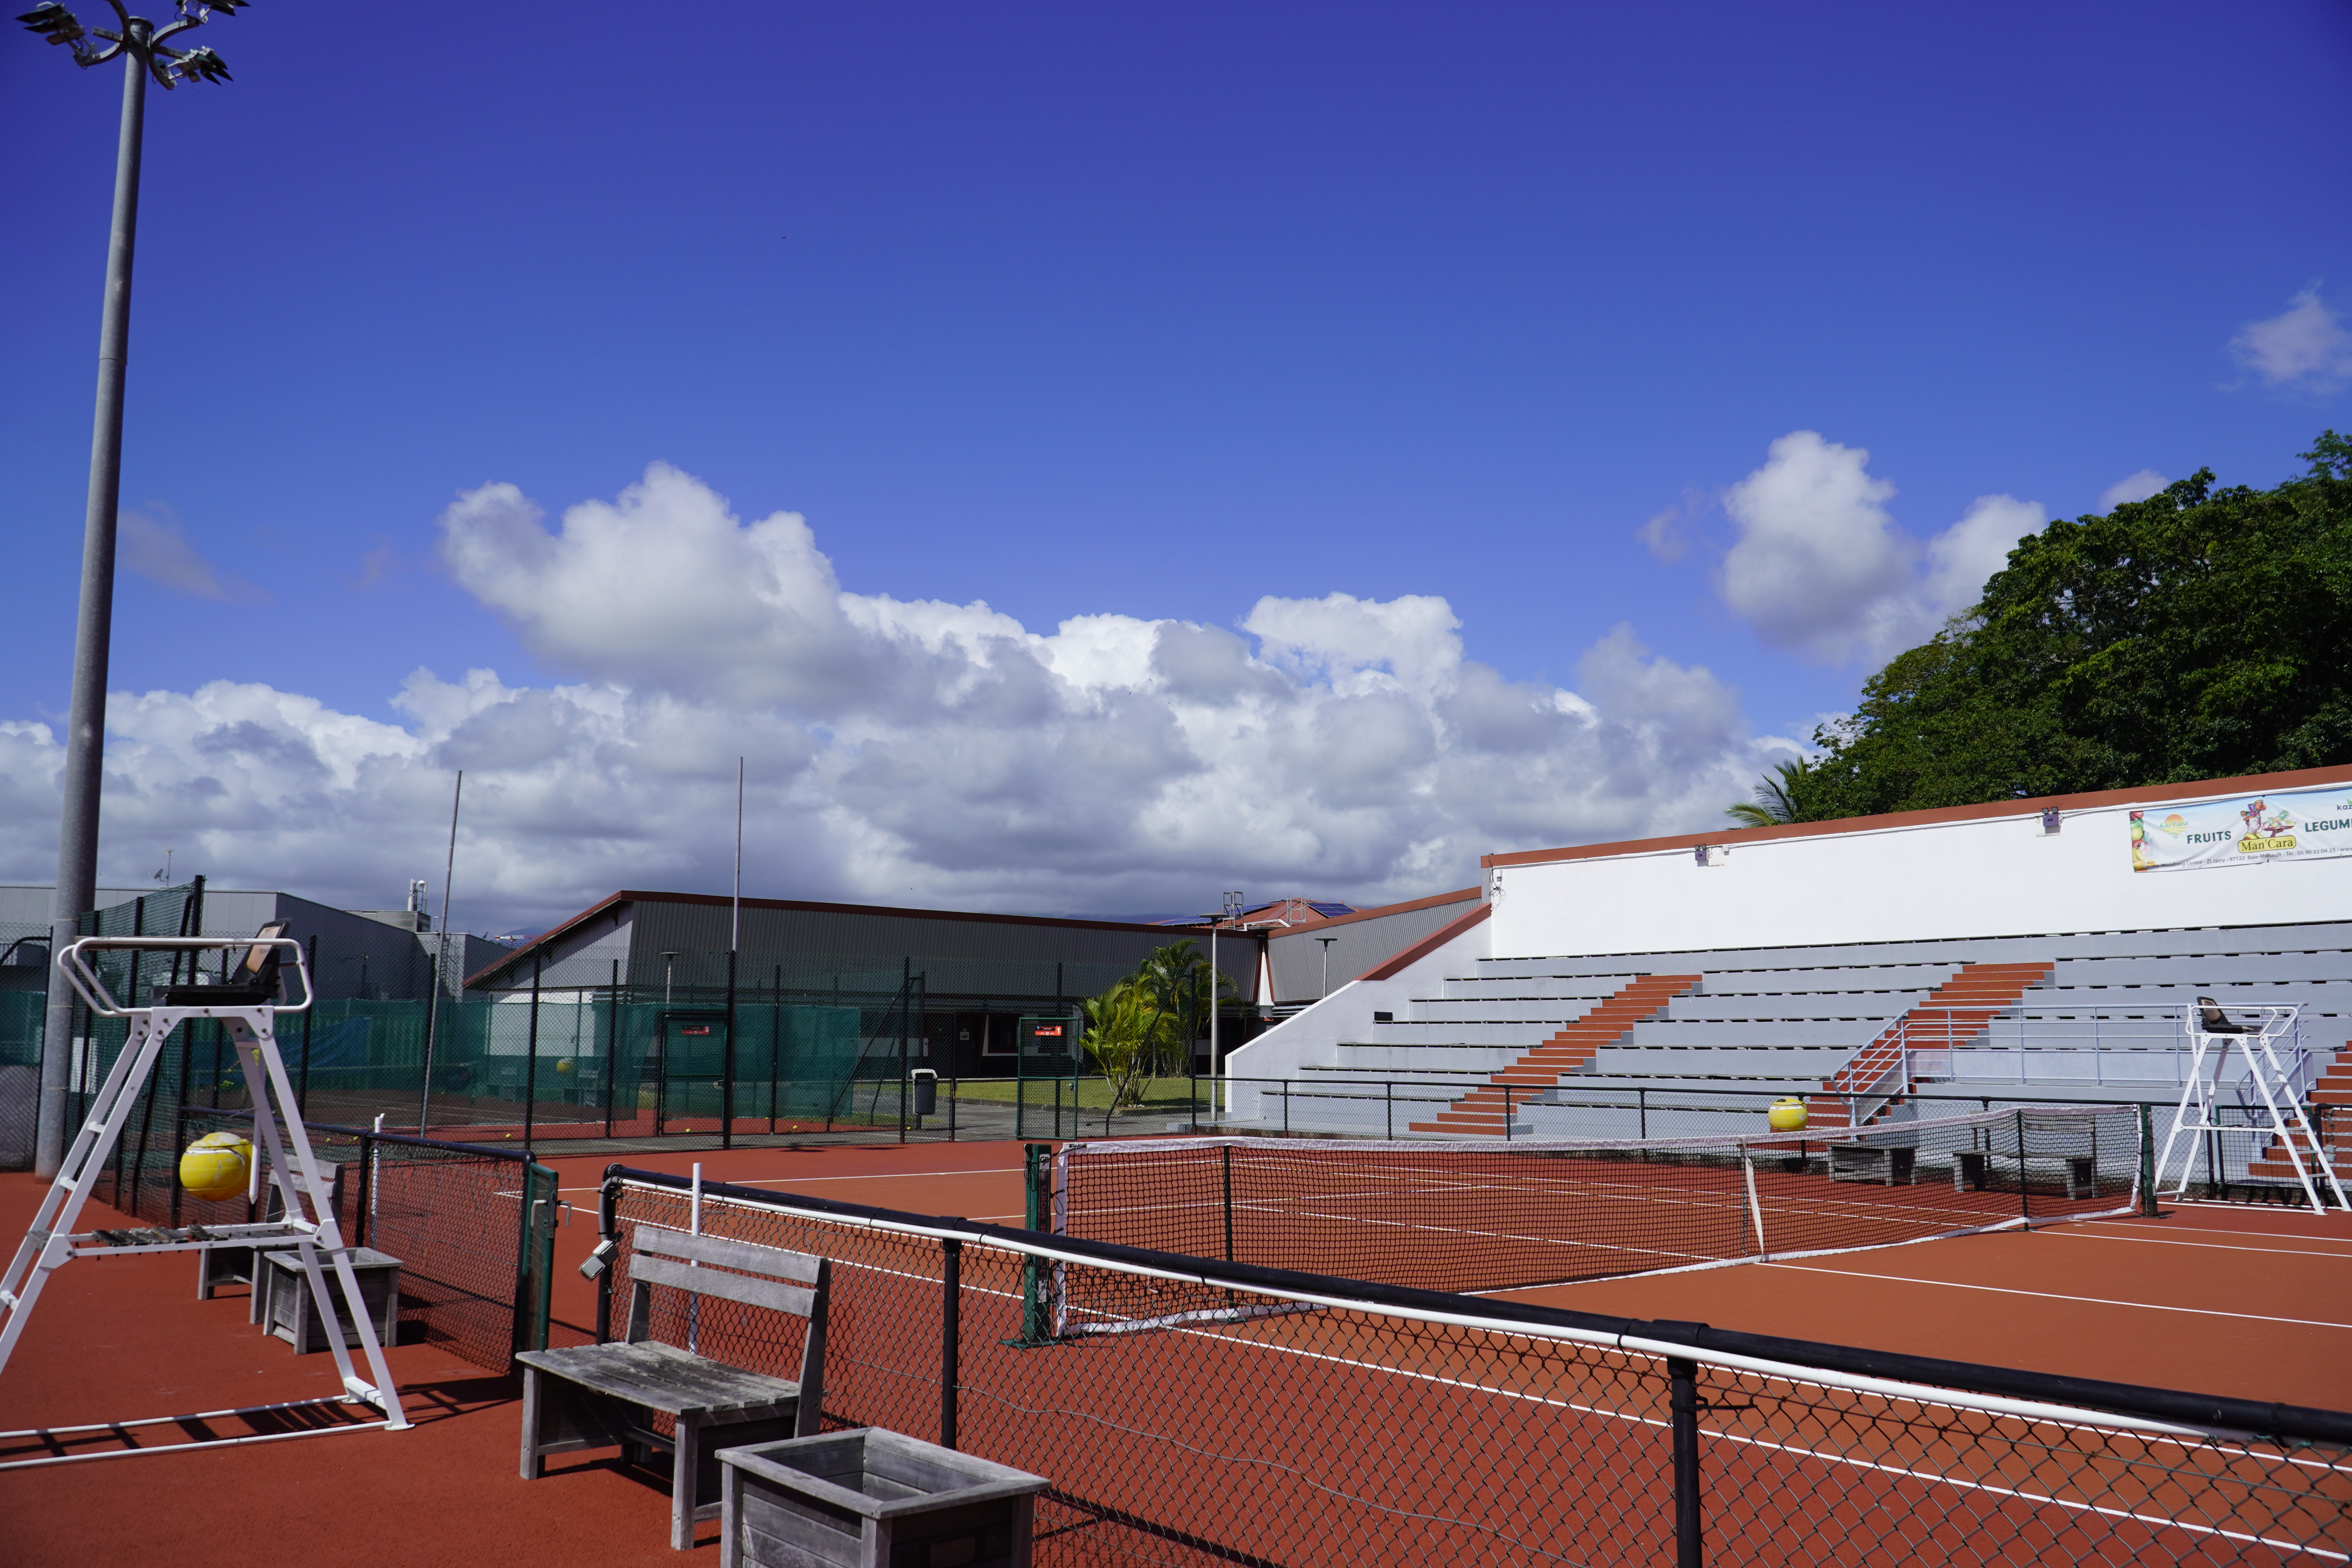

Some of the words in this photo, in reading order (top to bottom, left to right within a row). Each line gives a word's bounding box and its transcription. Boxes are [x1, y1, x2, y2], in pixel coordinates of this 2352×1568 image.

[2305, 818, 2352, 832] LEGUM
[2187, 831, 2231, 844] FRUITS
[2241, 839, 2294, 851] Man'Cara
